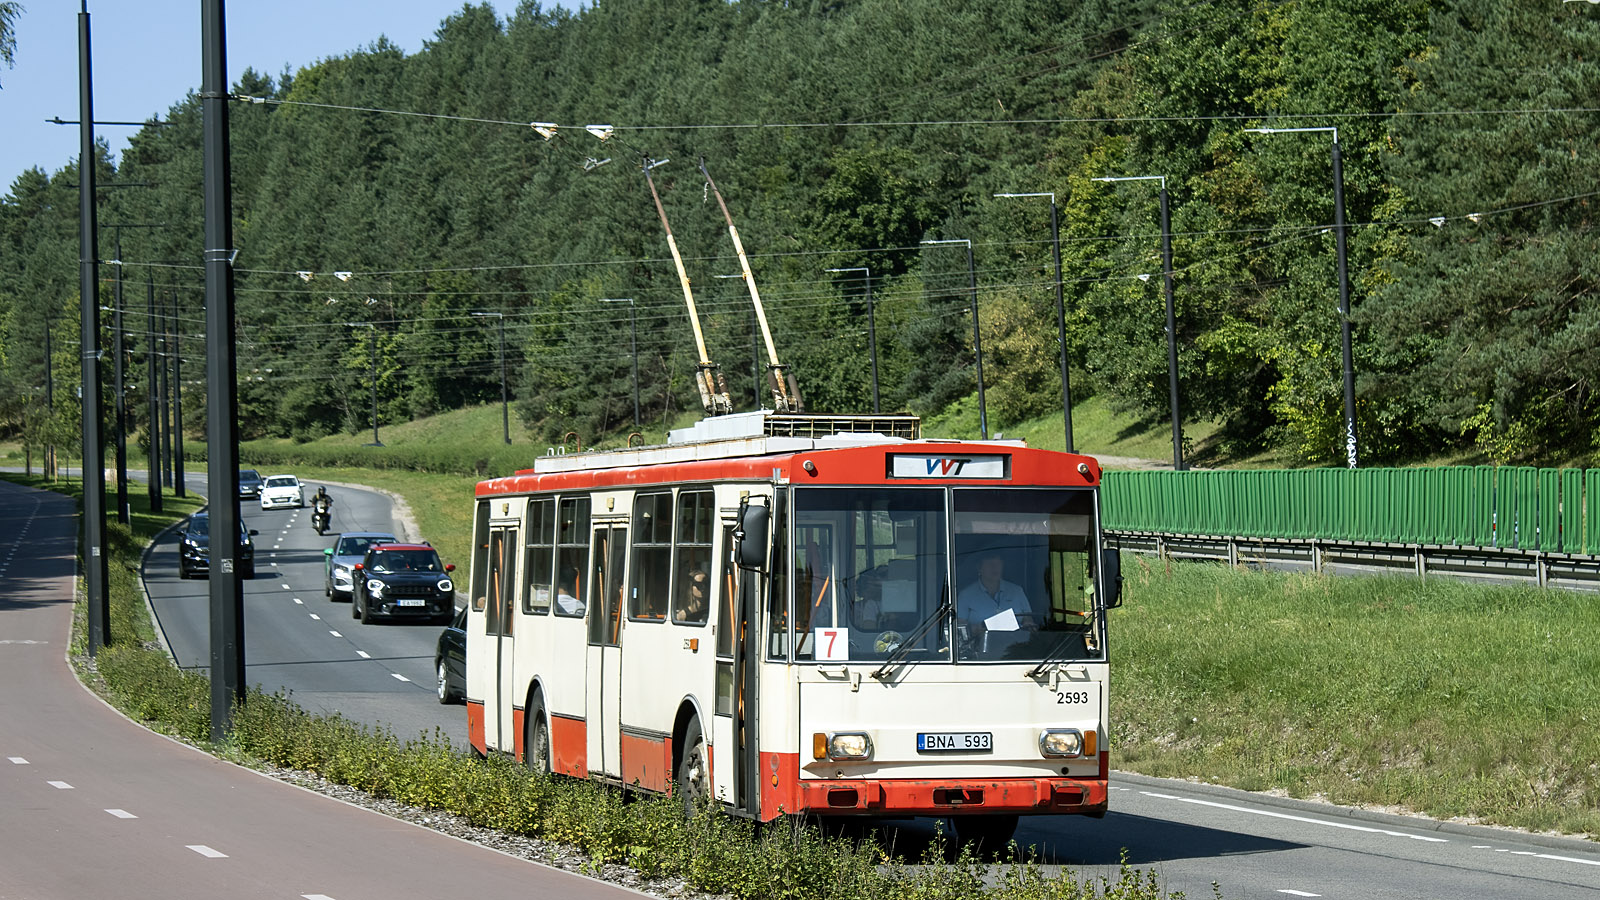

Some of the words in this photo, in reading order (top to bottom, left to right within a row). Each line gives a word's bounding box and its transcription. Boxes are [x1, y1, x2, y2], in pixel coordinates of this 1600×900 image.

[926, 458, 972, 476] VVT
[824, 631, 837, 658] 7
[1057, 691, 1088, 704] 2593
[926, 735, 956, 748] BNA
[964, 735, 989, 748] 593
